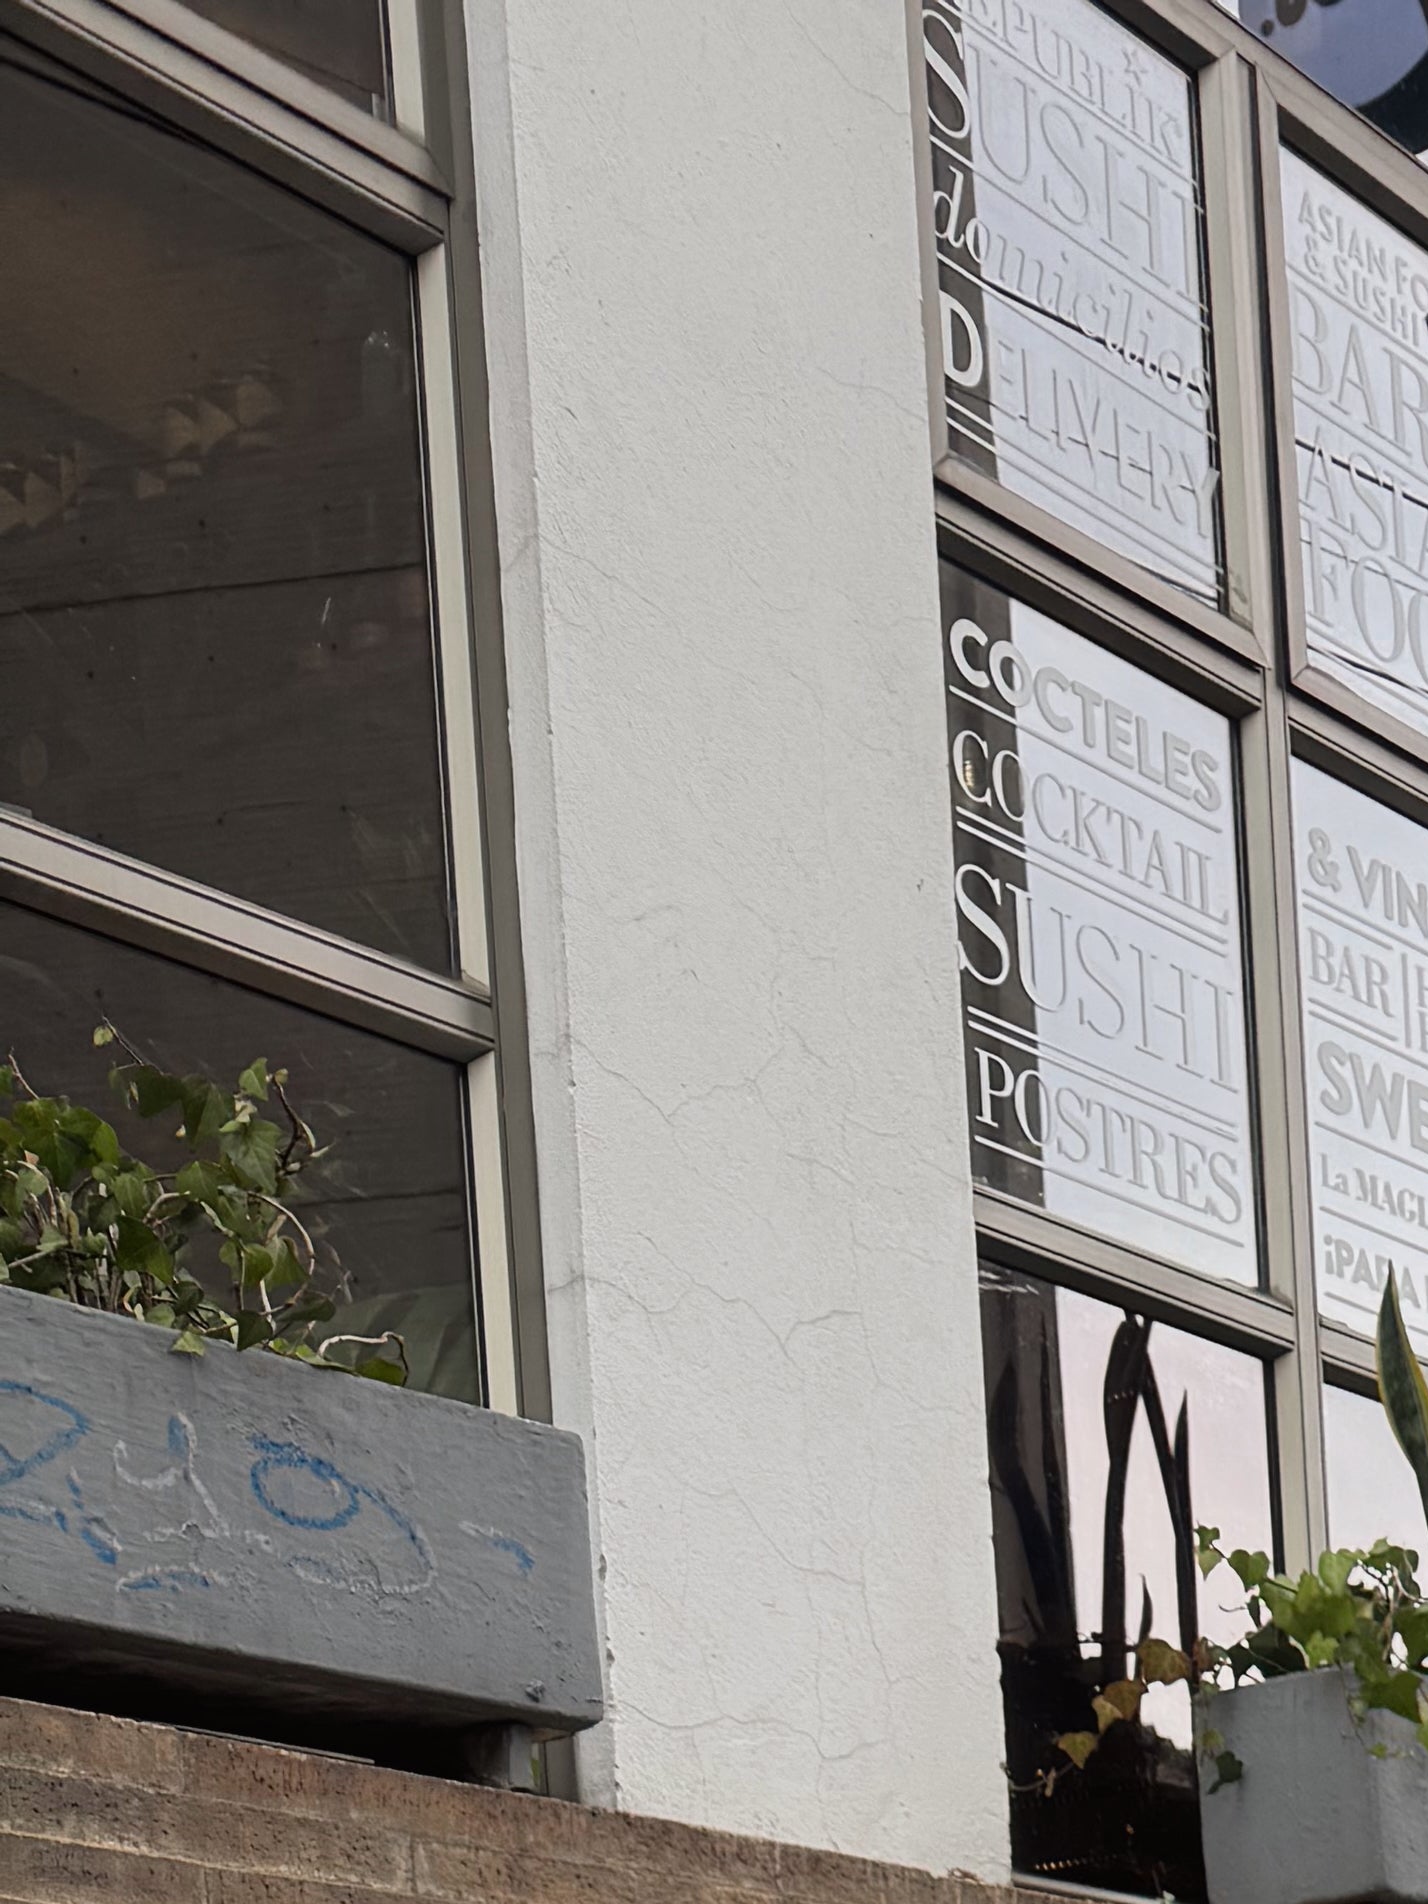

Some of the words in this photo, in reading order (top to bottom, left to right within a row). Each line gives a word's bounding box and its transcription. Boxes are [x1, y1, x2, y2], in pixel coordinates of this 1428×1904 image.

[922, 9, 1207, 313] SUSHI
[1298, 190, 1389, 283] ASIAN
[934, 164, 1210, 412] domicilios
[1333, 253, 1420, 347] SUSHI
[939, 288, 1221, 538] DELIVERY
[950, 618, 1223, 812] COCTELES
[1307, 827, 1342, 893] &
[952, 730, 1229, 926] COCKTAIL
[955, 864, 1239, 1094] SUSHI
[1308, 926, 1396, 1019] BAR
[974, 1047, 1243, 1226] POSTRES
[1319, 1152, 1350, 1196] La
